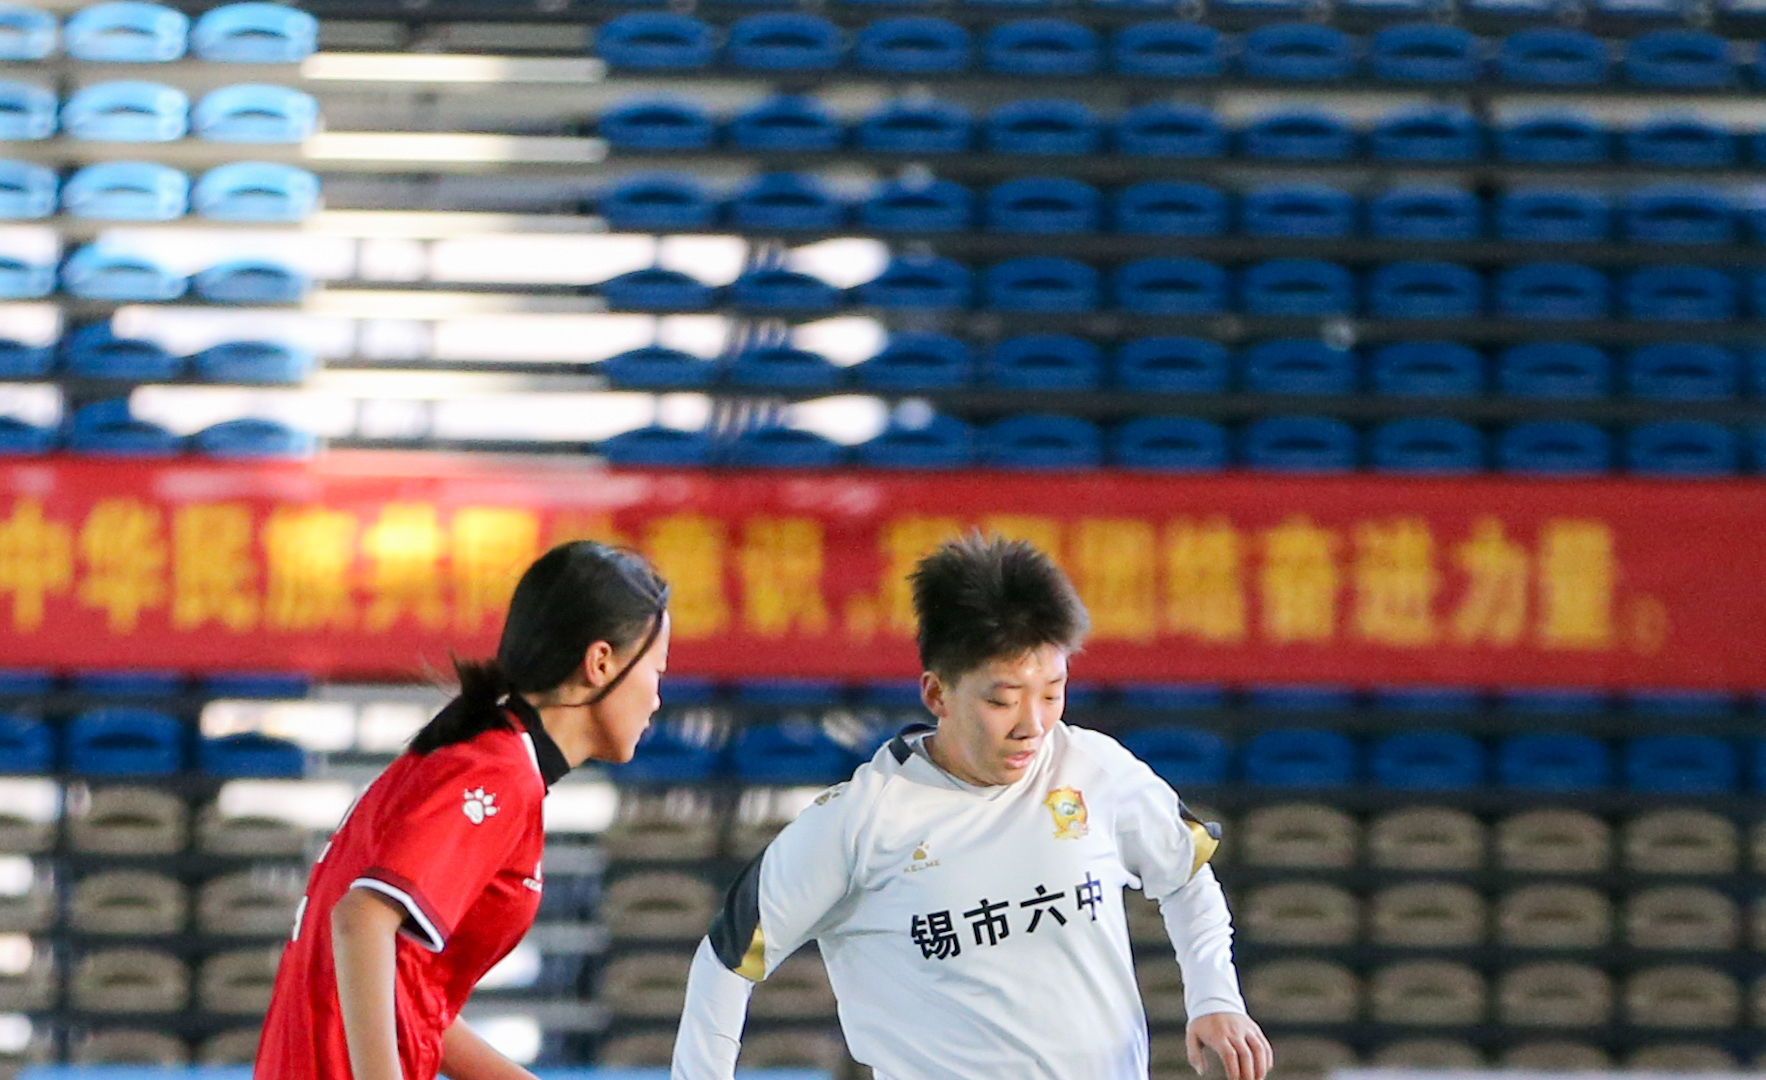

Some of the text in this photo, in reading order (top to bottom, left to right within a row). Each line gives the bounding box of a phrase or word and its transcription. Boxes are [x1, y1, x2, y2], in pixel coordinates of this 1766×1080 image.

[903, 859, 940, 874] KELME
[910, 871, 1103, 961] 锡市六中
